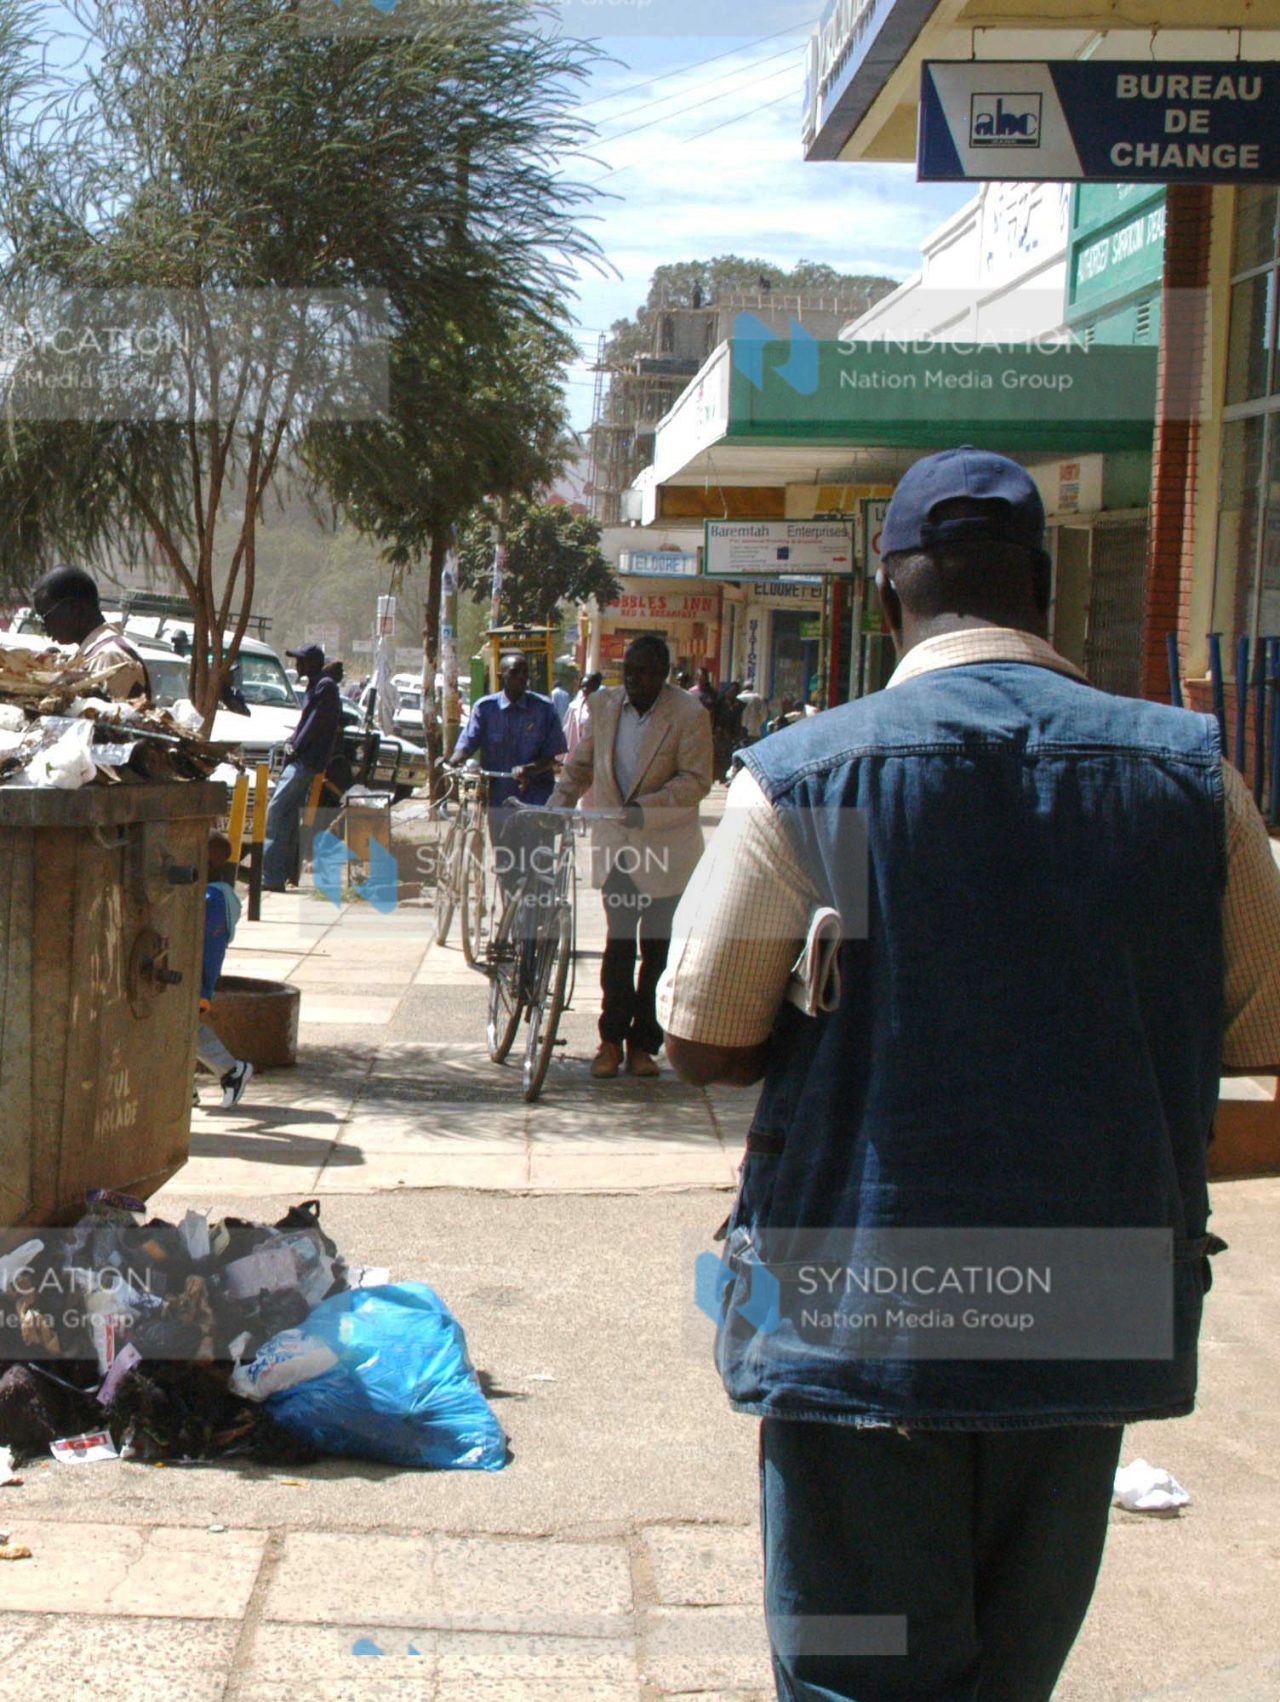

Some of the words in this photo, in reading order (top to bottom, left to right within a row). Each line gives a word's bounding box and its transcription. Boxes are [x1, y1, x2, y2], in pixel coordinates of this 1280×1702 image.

[1116, 74, 1262, 100] BUREAU
[975, 98, 1038, 136] abc
[1164, 109, 1210, 134] DE
[1110, 142, 1261, 168] CHANGE
[787, 524, 849, 540] Enterprises
